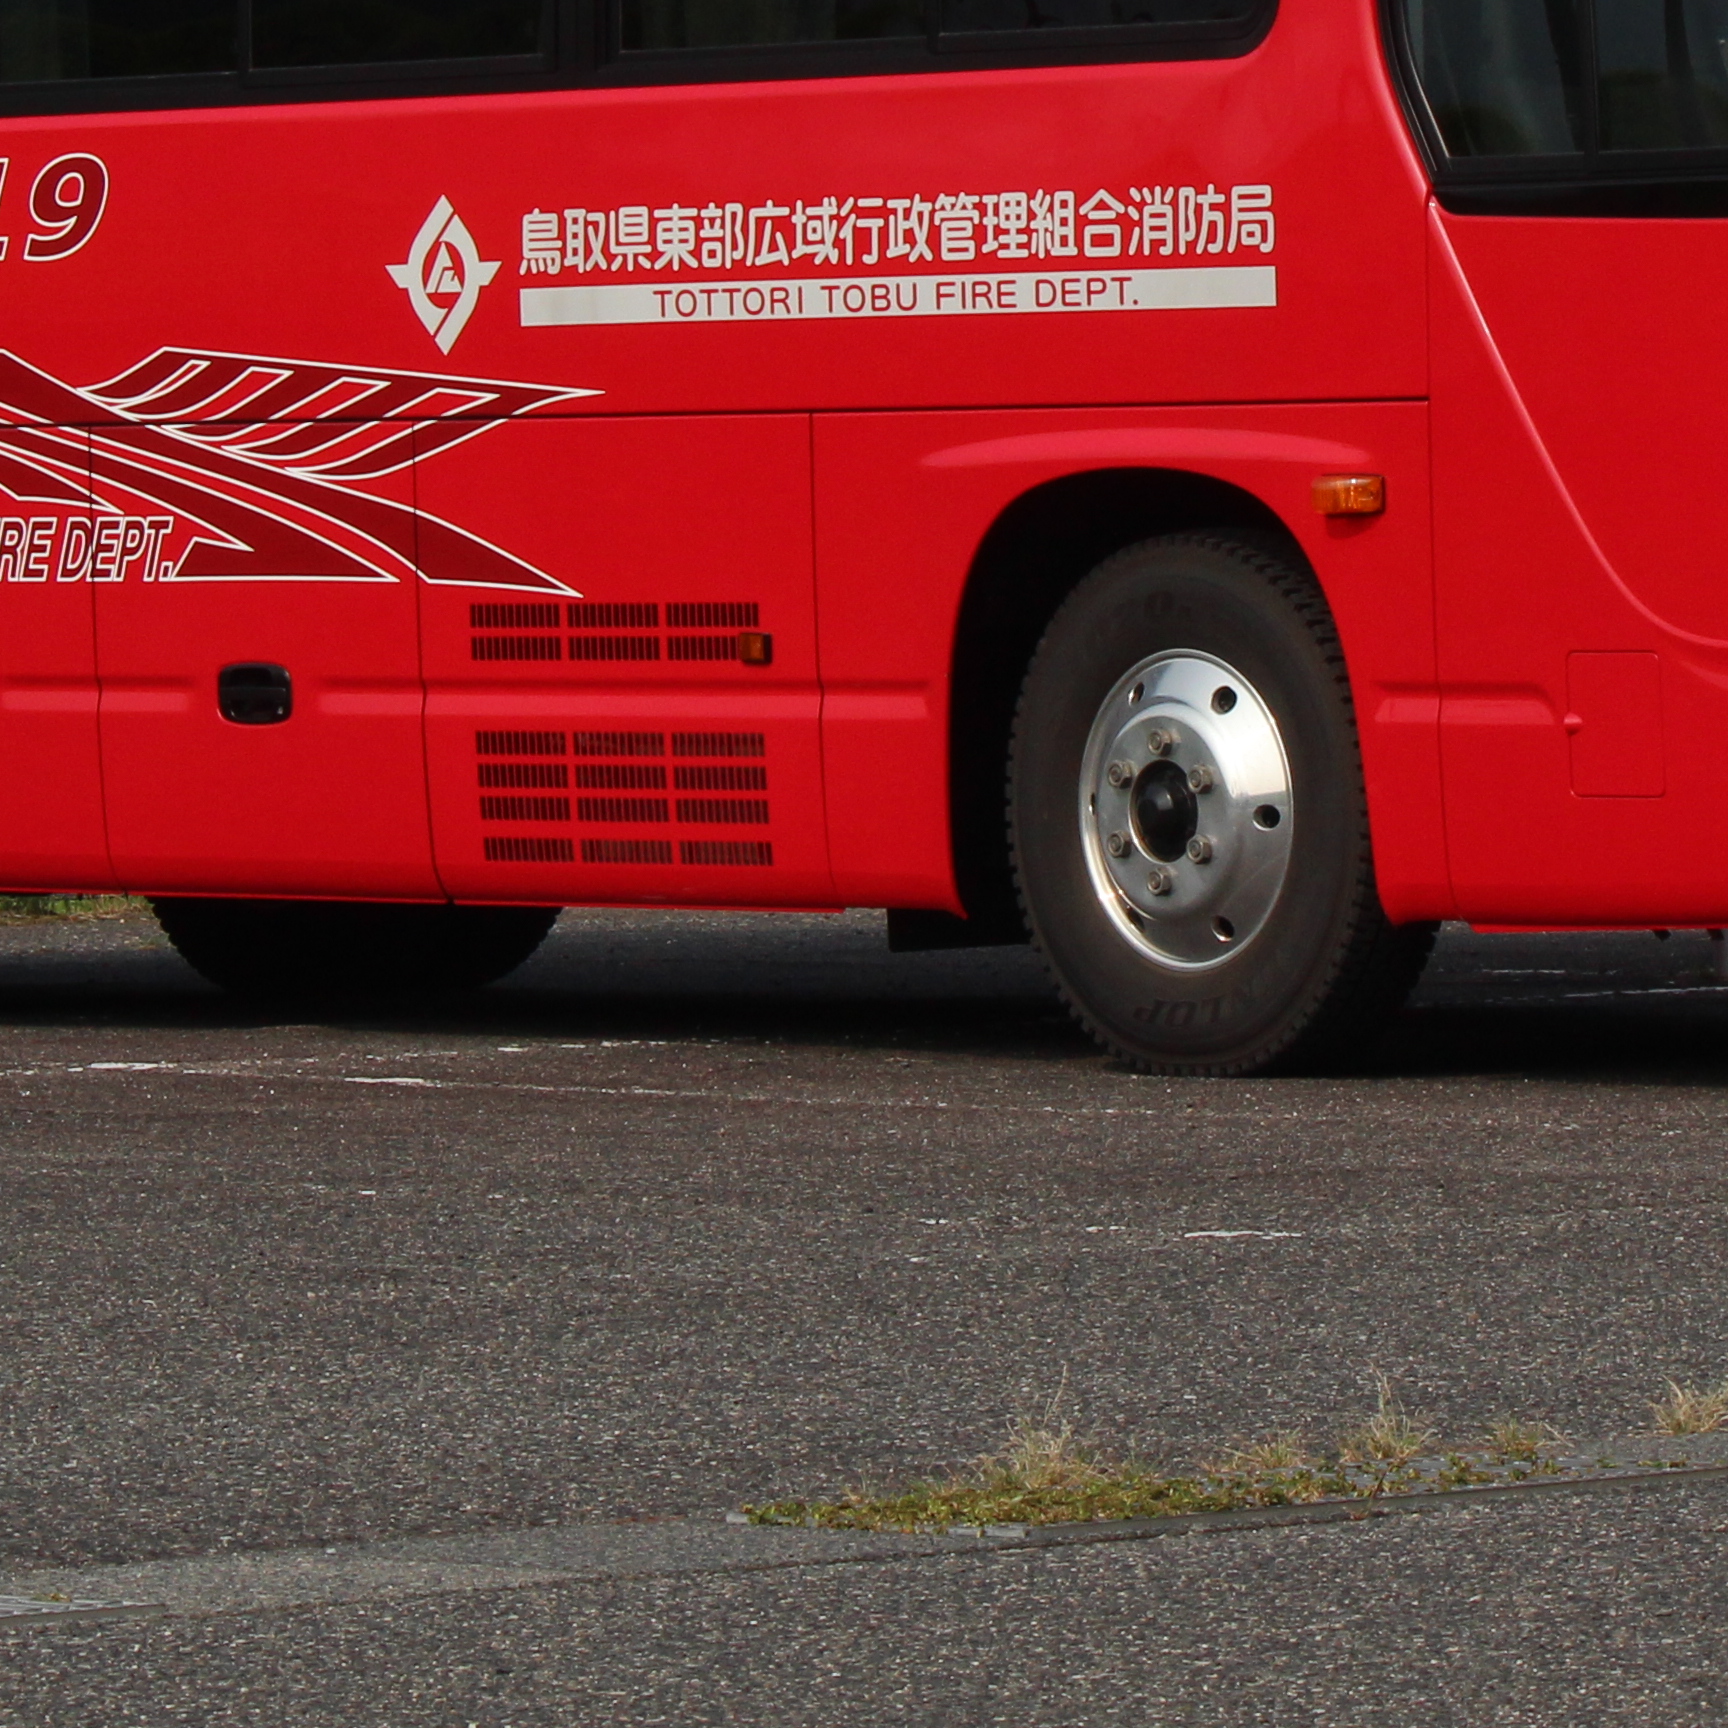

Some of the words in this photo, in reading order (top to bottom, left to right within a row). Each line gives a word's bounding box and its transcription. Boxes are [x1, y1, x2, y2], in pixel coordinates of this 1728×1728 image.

[519, 183, 1275, 276] 鳥取県東部広域行政管理組合消防局
[653, 285, 804, 318] TOTTORI
[819, 281, 918, 314] TOBU
[935, 278, 1017, 311] FIRE
[1035, 276, 1139, 308] DEPT.
[55, 515, 174, 583] DEPT.
